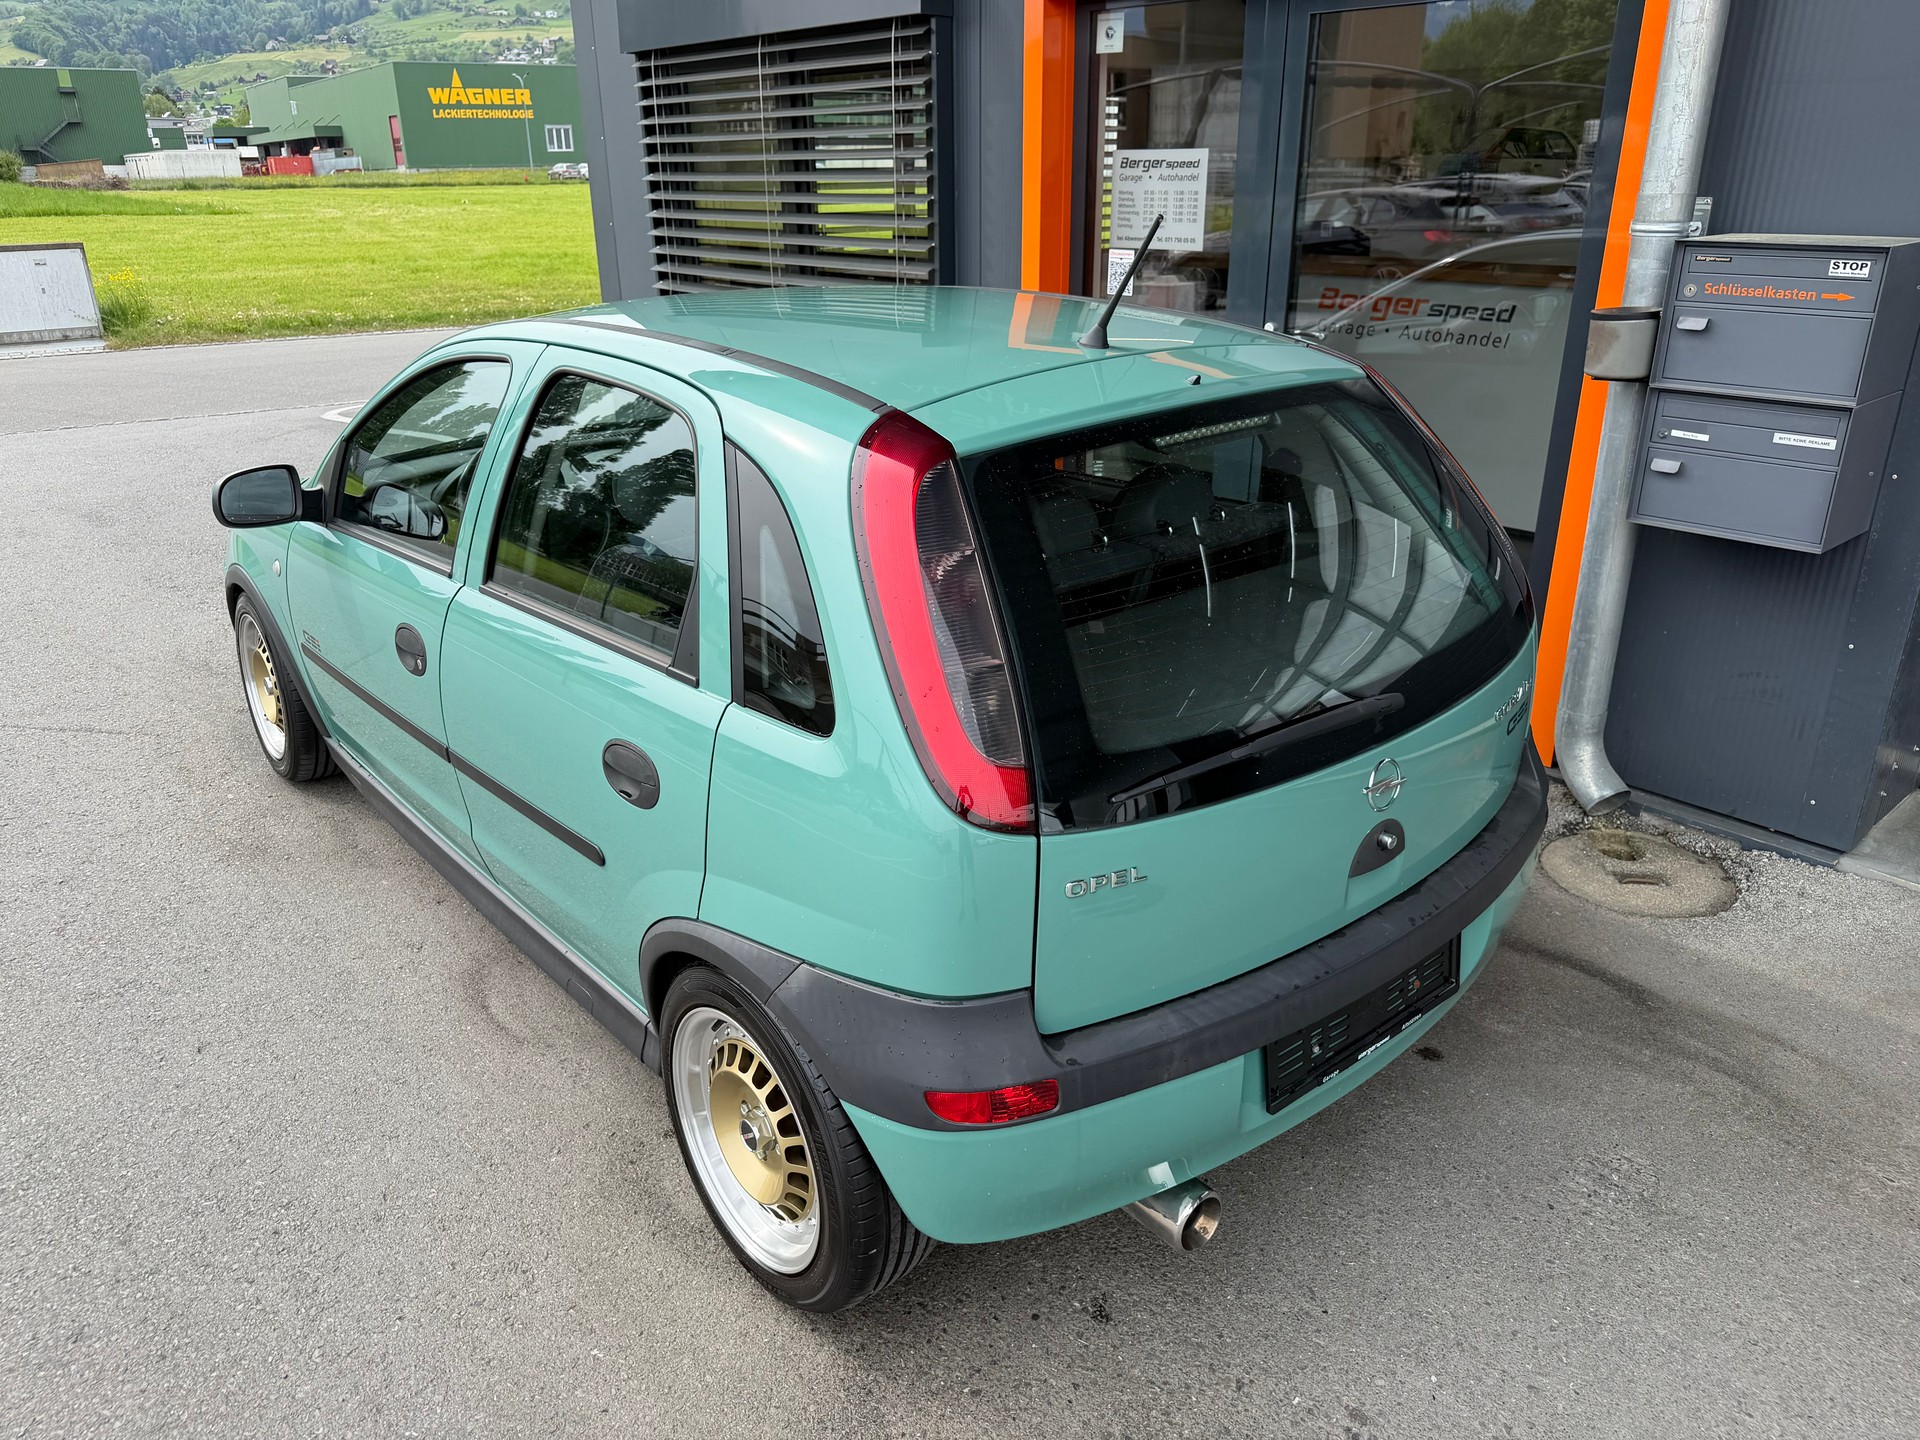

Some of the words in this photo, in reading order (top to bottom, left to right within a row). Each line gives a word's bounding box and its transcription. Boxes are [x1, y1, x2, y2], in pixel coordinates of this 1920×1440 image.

[1120, 157, 1201, 172] Bergerspeed
[1119, 173, 1143, 183] Garage
[1157, 173, 1200, 181] Autohandel
[1832, 261, 1869, 271] STOP
[1704, 283, 1817, 300] Schlüsselkasten
[1317, 287, 1518, 323] Bergerspeed
[1319, 320, 1376, 340] Garage
[1398, 325, 1511, 349] Autohandel
[1065, 866, 1148, 898] OPEL
